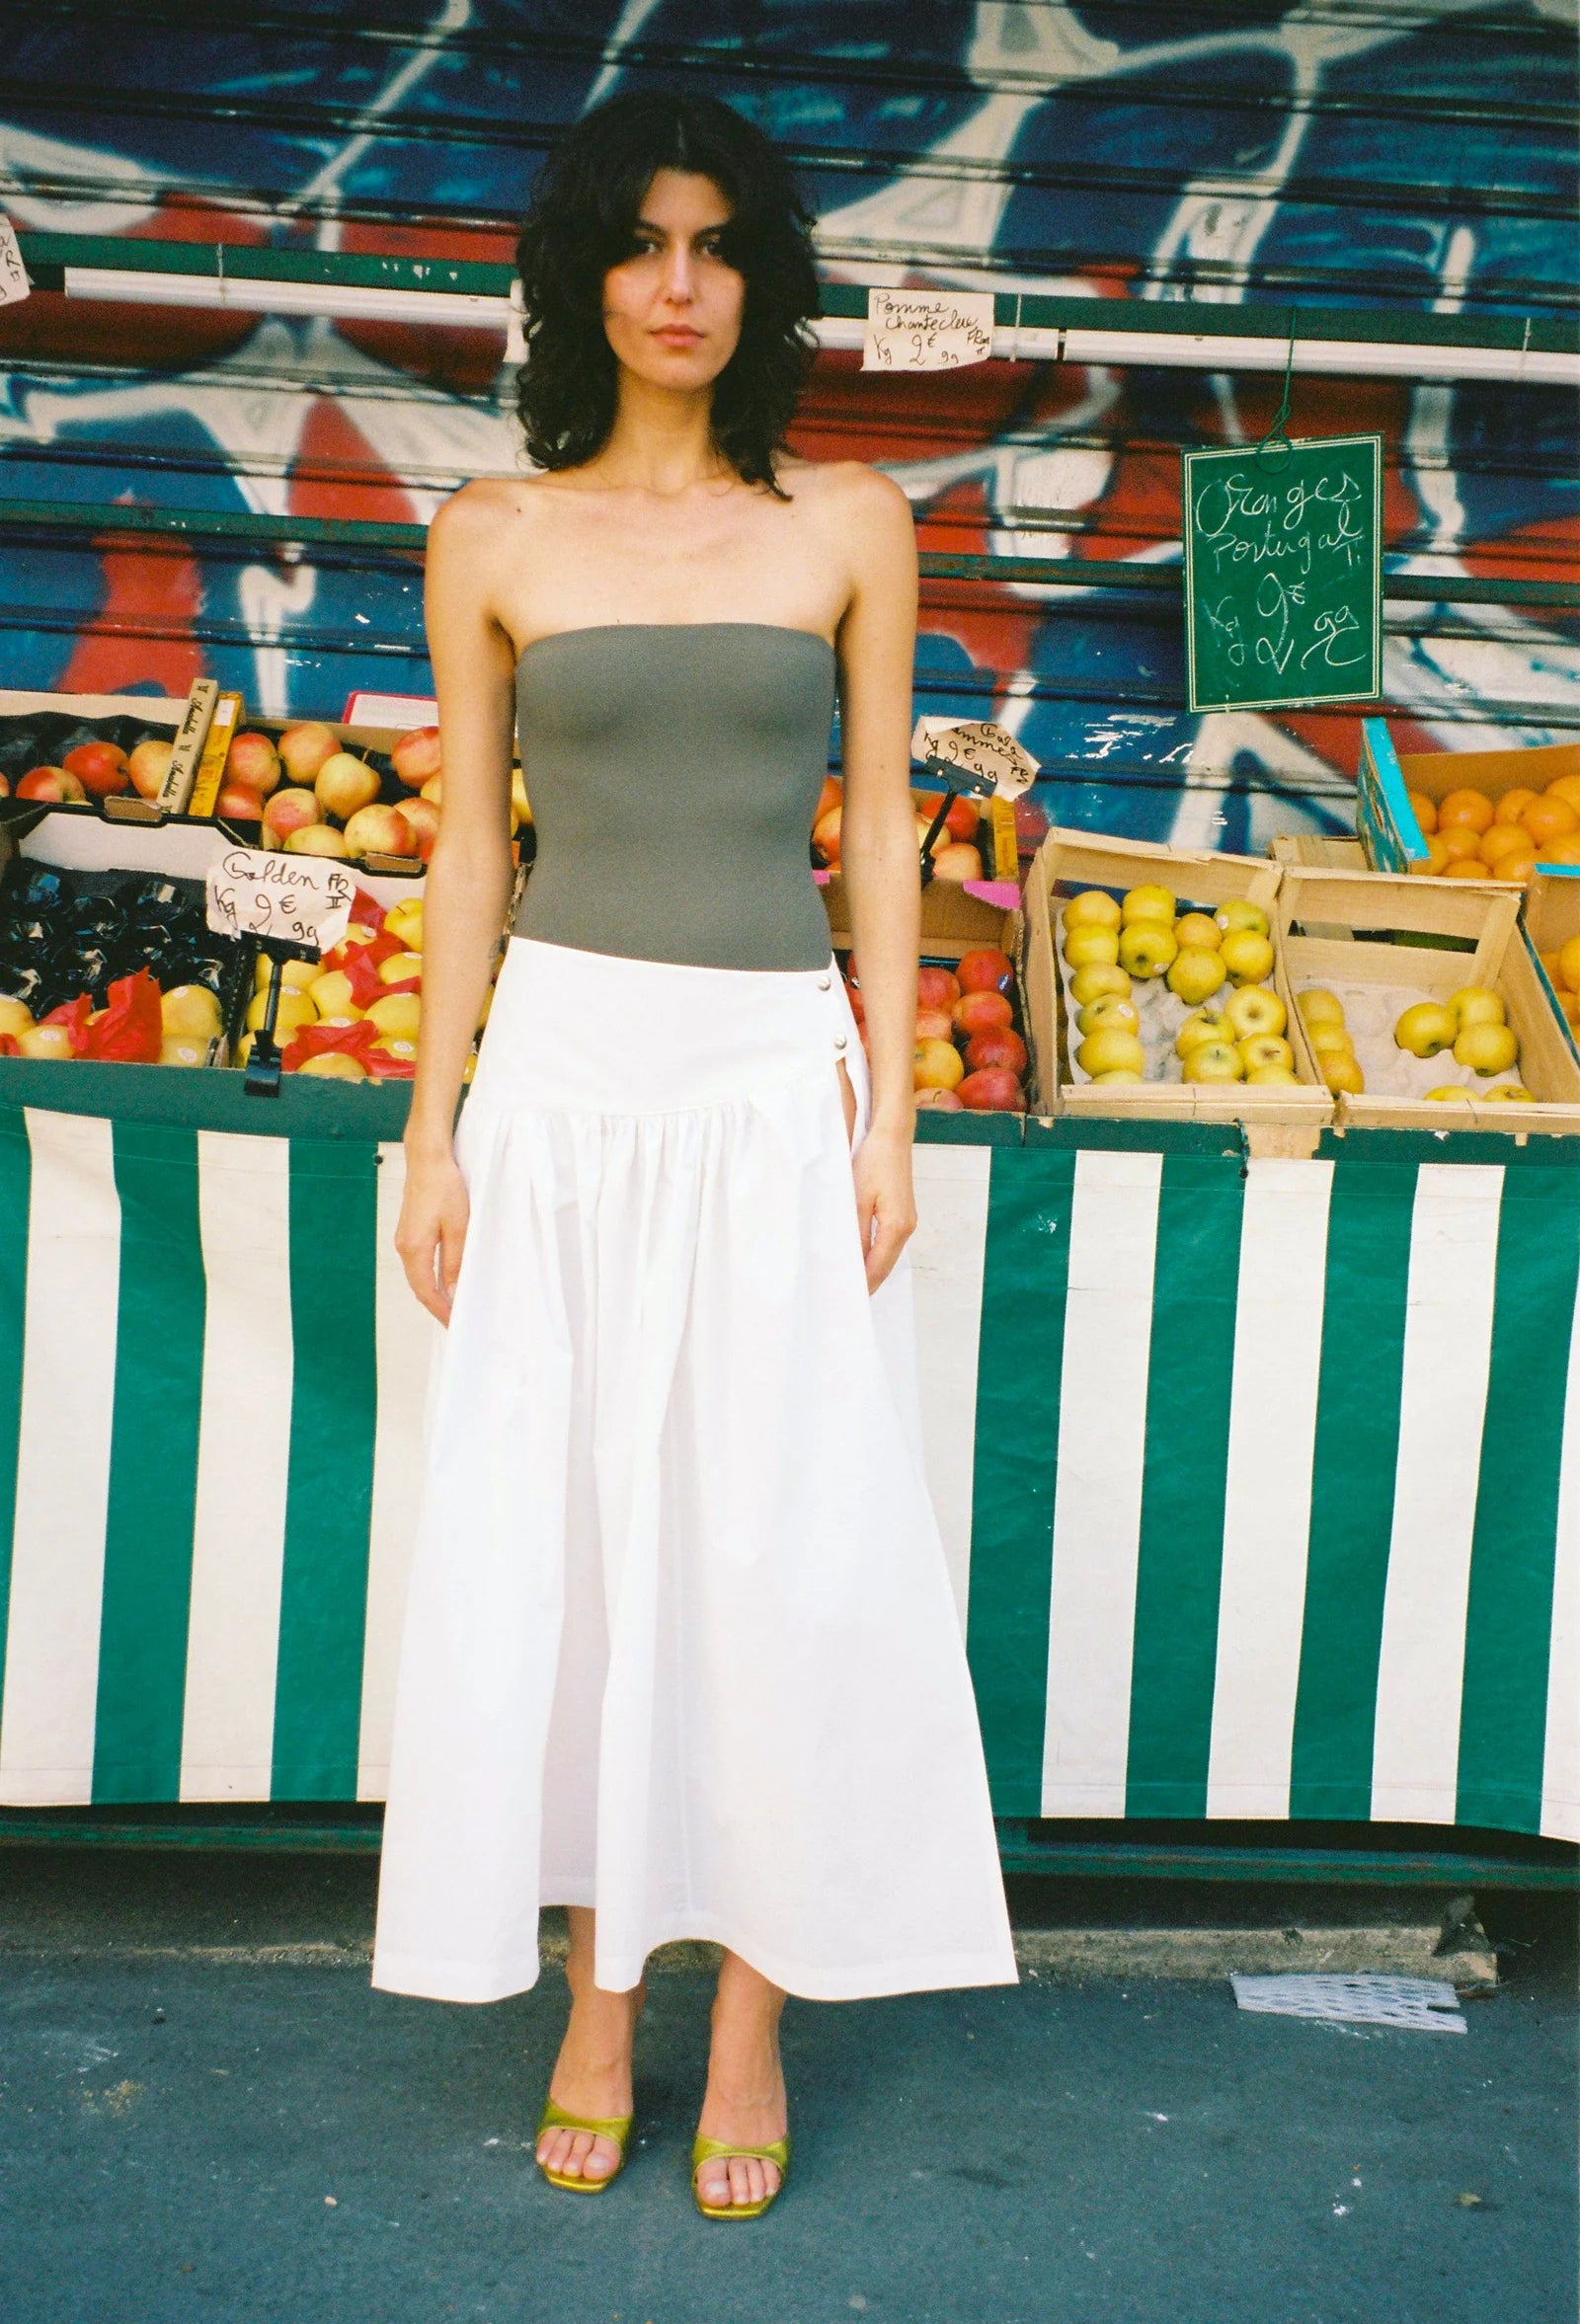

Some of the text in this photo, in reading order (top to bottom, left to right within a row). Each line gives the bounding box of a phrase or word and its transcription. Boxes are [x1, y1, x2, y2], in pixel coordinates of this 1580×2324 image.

[874, 292, 949, 314] Pomme
[1196, 473, 1363, 538] Oranges
[1207, 502, 1364, 574] Portugal
[981, 723, 1023, 760] Gala
[222, 851, 319, 891] Golden
